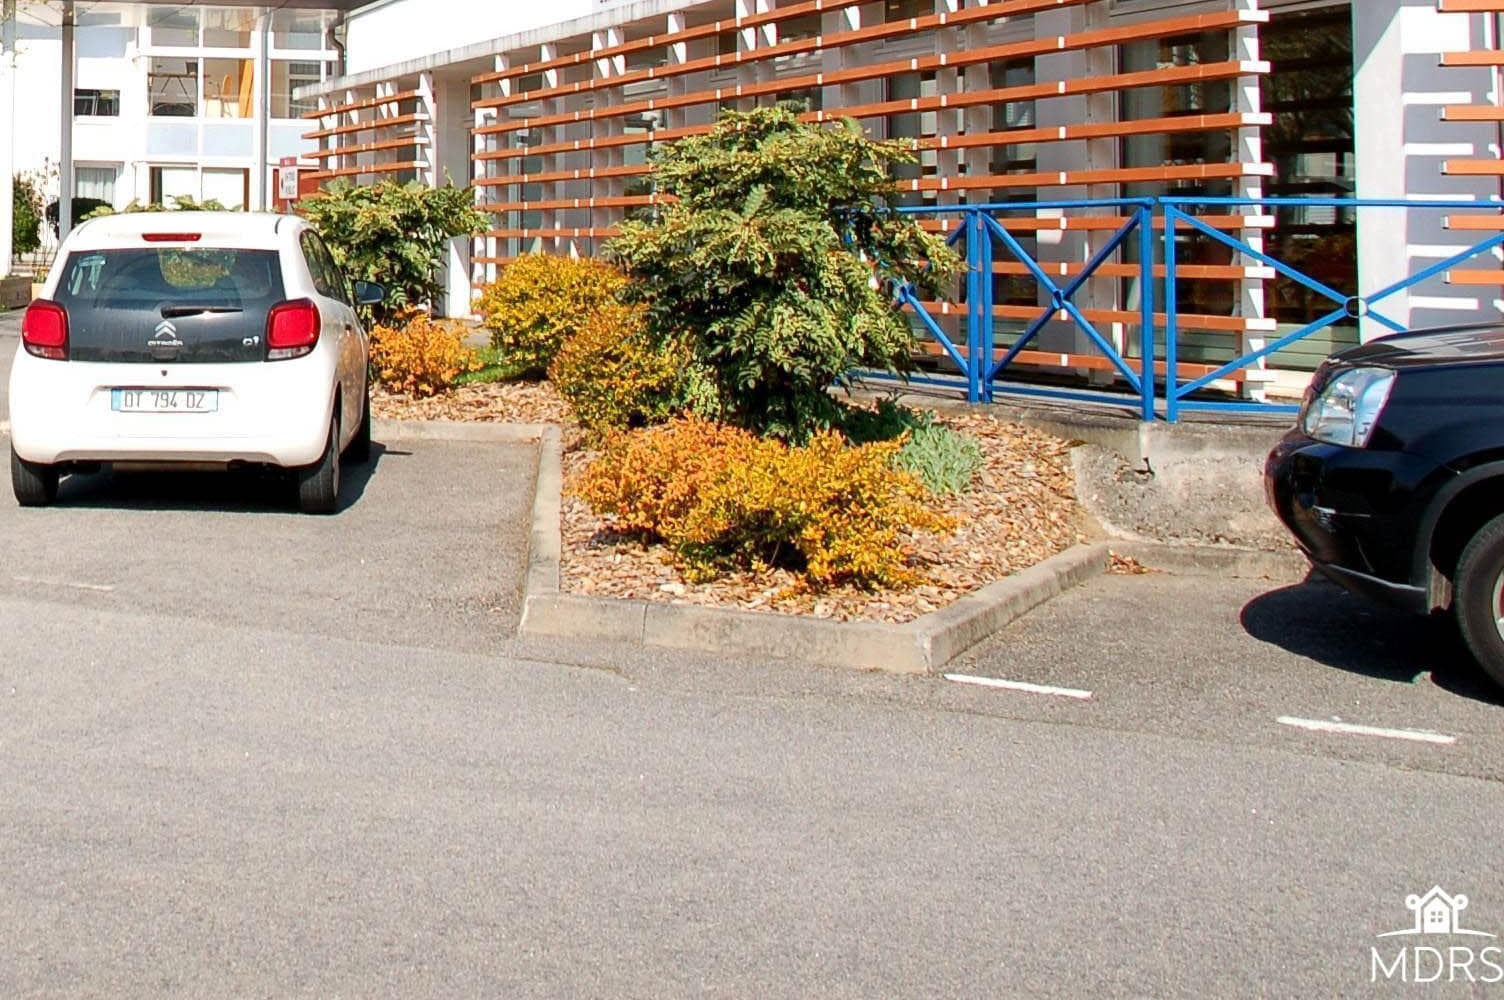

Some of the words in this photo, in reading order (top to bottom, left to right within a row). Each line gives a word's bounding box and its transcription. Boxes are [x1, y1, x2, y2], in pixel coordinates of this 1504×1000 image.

[124, 391, 143, 408] DT
[150, 391, 178, 408] 794
[186, 391, 205, 409] DZ
